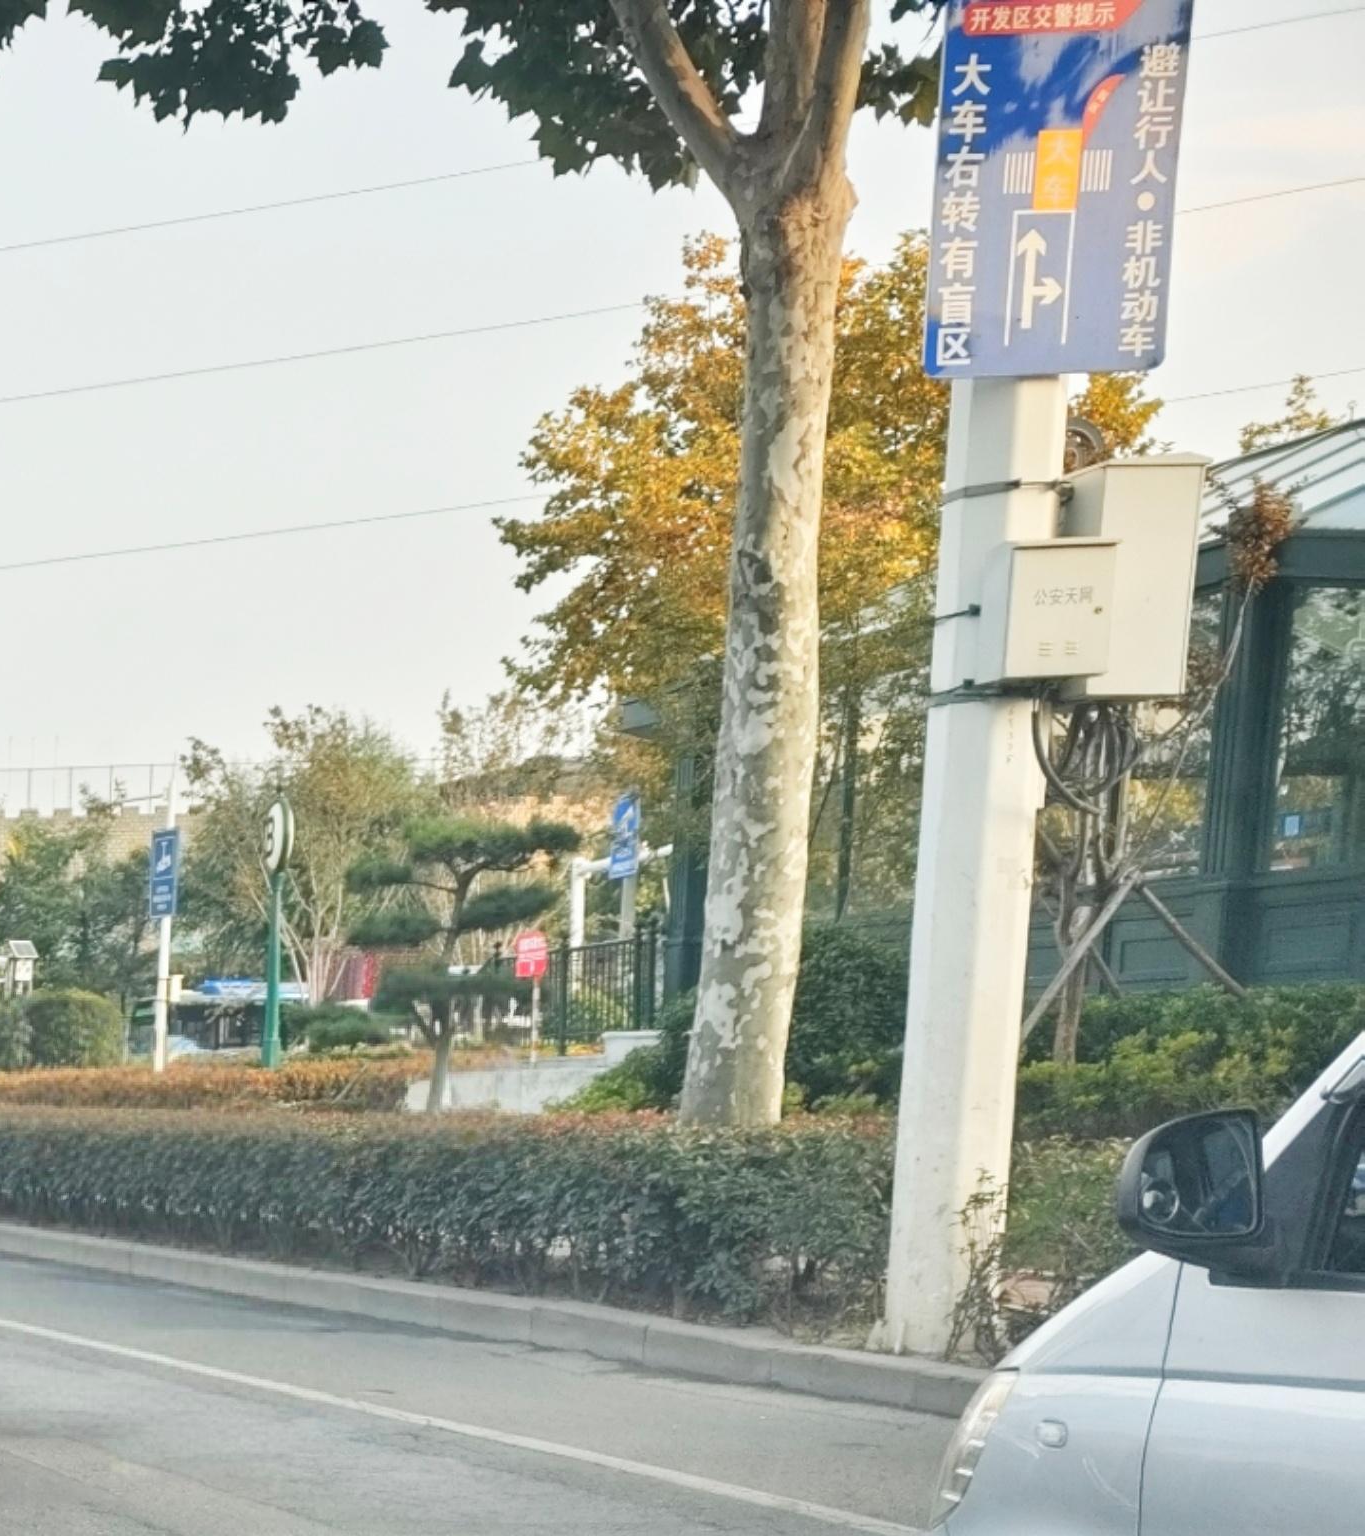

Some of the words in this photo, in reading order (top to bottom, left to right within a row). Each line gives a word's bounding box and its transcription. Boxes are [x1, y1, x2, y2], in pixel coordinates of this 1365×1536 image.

[970, 2, 1117, 32] 开发区交警提示
[936, 53, 992, 366] 大车右转有盲区
